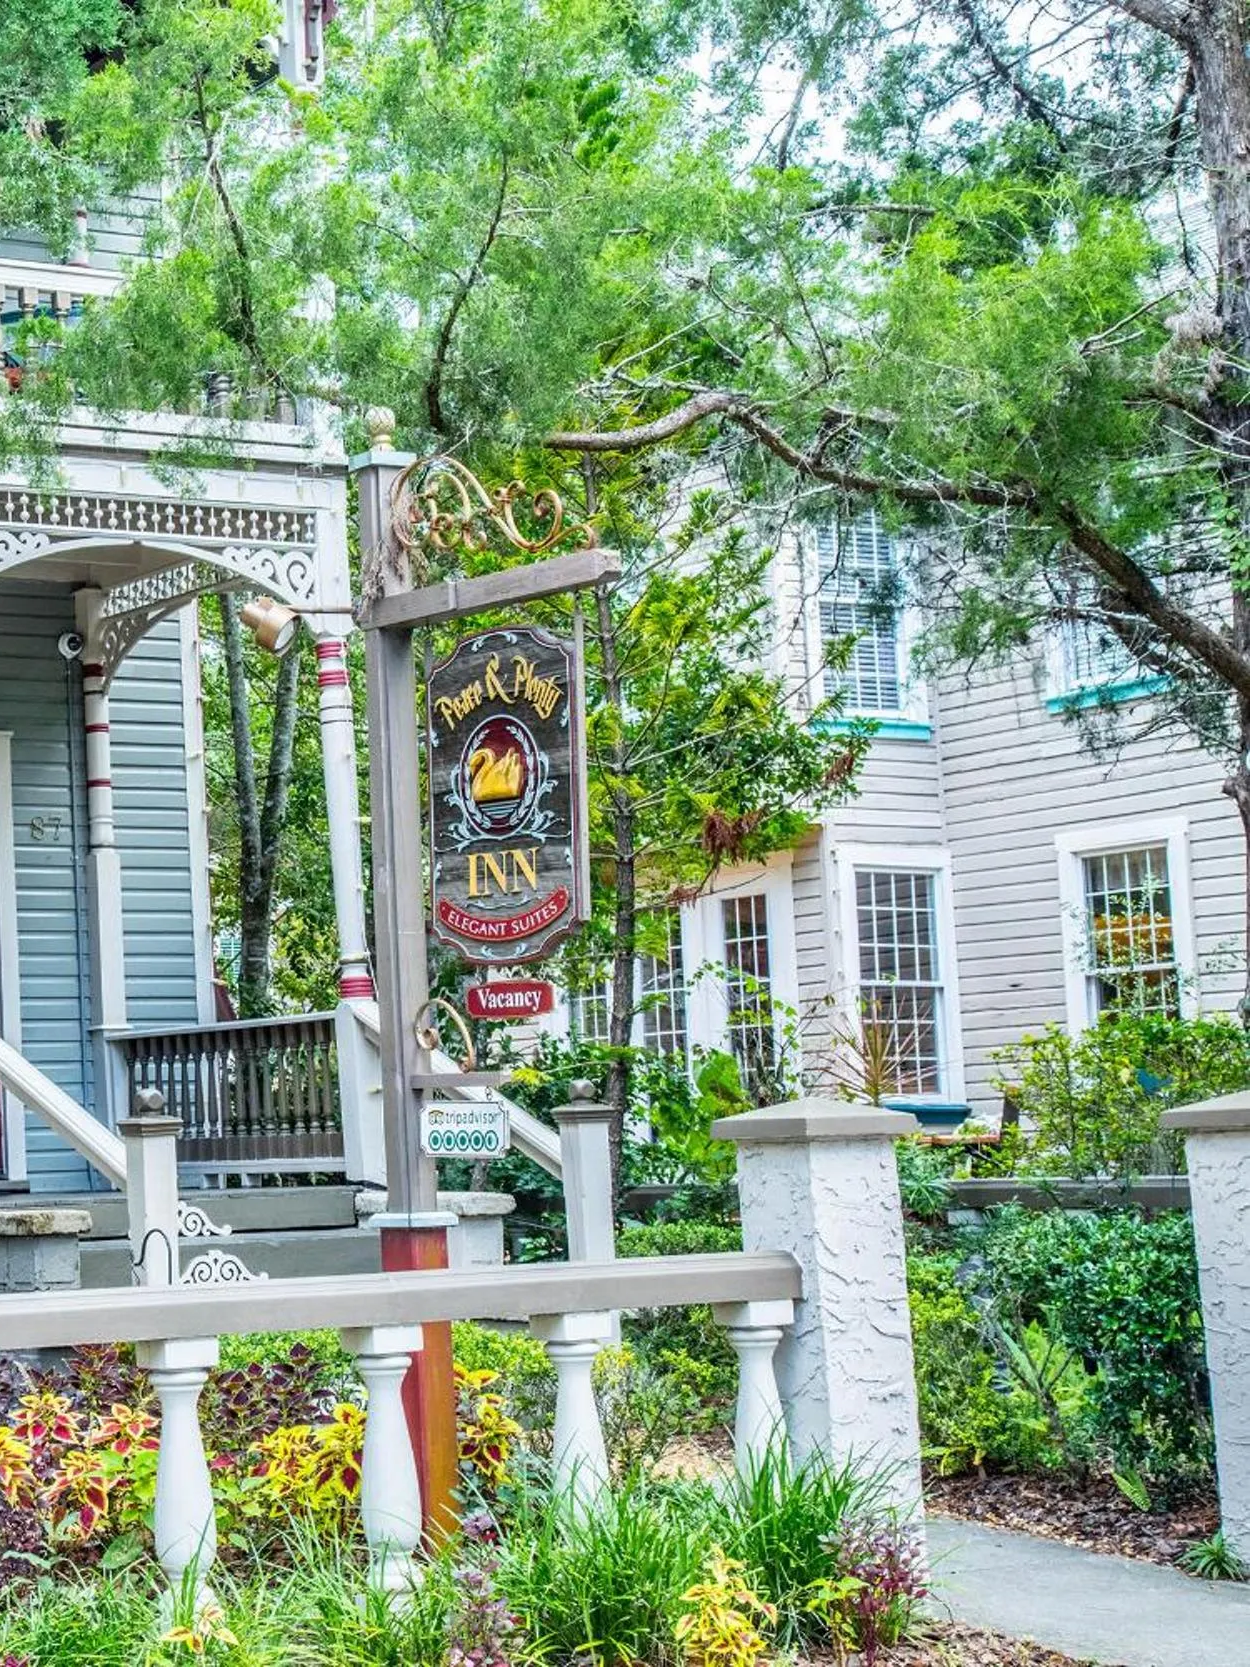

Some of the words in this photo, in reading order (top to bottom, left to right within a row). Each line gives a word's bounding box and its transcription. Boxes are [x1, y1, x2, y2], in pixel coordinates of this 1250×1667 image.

[484, 651, 517, 704] &
[510, 655, 565, 720] Plenty
[31, 816, 62, 841] 87
[466, 846, 540, 897] INN
[447, 910, 507, 936] ELEGANT
[510, 901, 558, 935] SUITES
[476, 987, 542, 1011] Vacancy
[445, 1109, 501, 1127] tripadvisor
